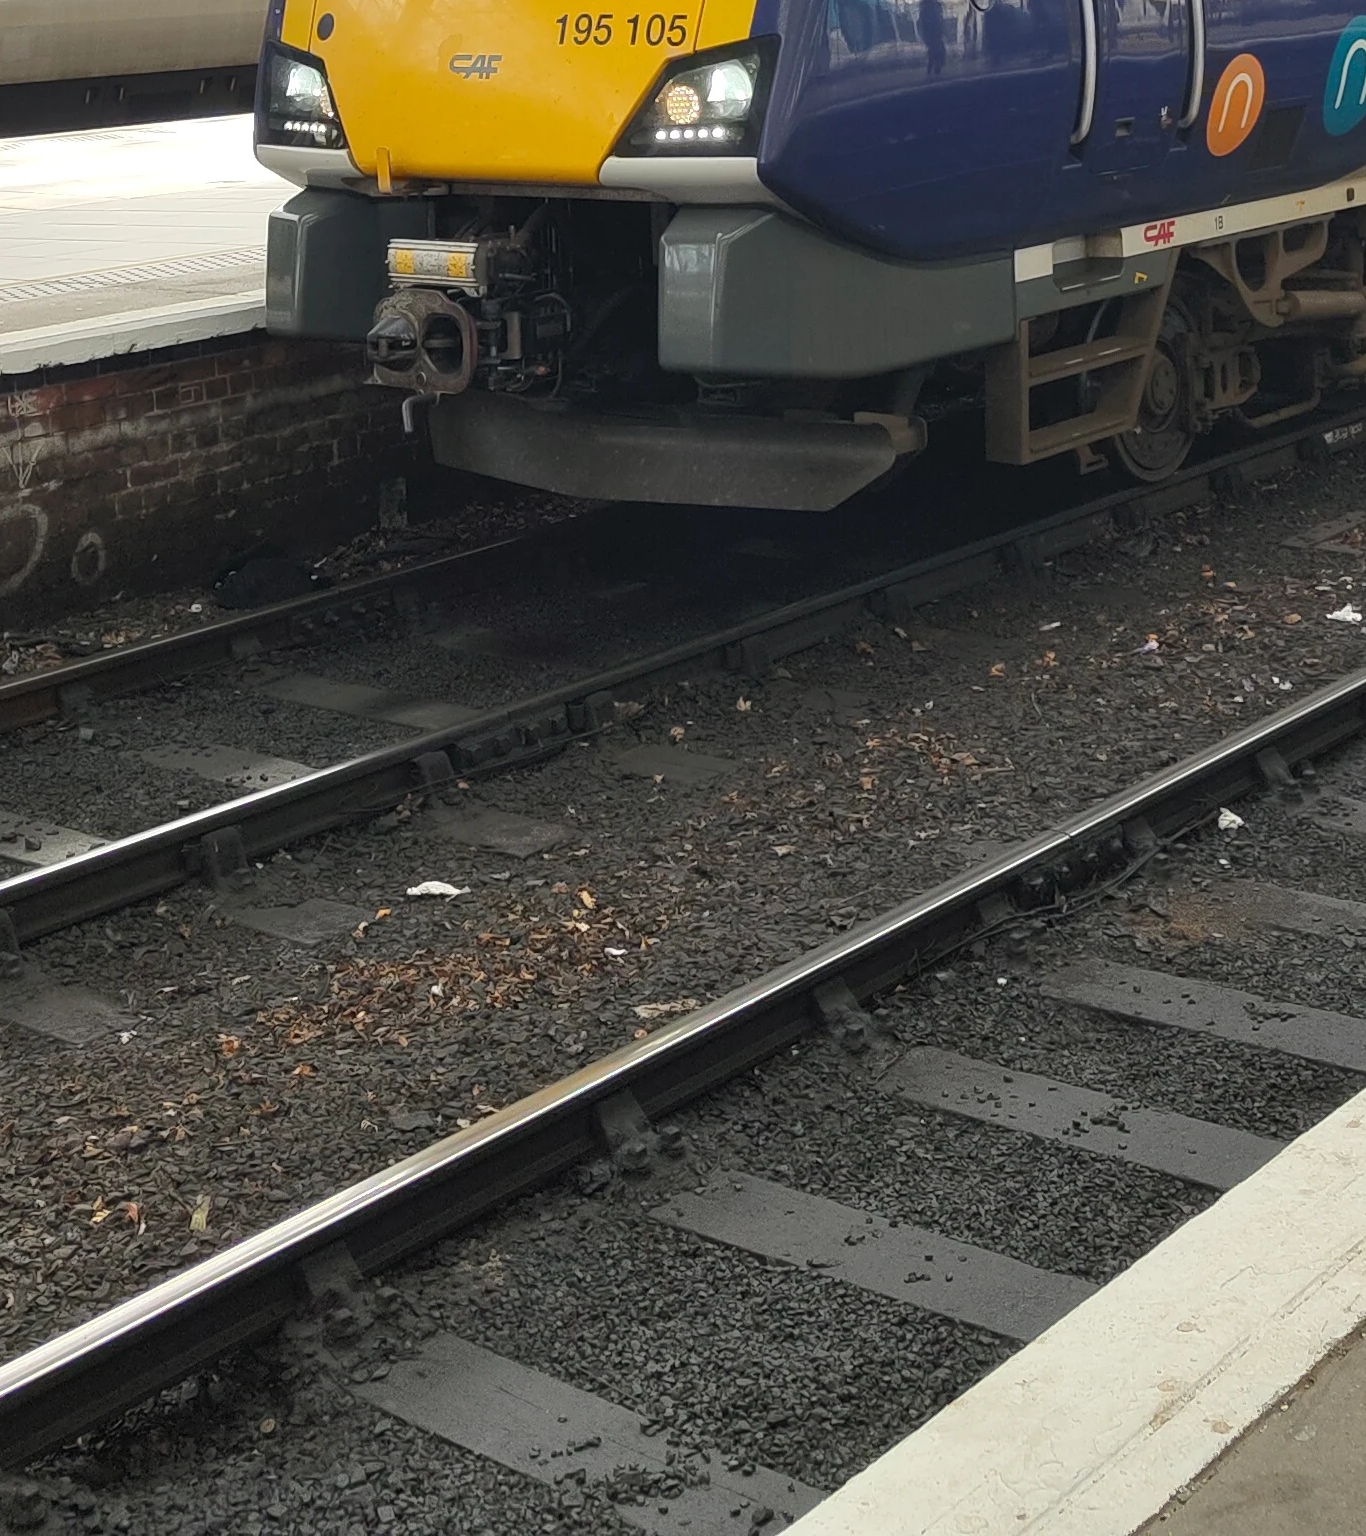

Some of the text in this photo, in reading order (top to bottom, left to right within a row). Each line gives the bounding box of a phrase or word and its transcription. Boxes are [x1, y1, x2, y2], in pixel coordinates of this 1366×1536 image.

[555, 13, 688, 47] 195 105
[449, 54, 503, 80] CAF
[1144, 220, 1176, 247] CAF
[1214, 215, 1224, 231] 1B
